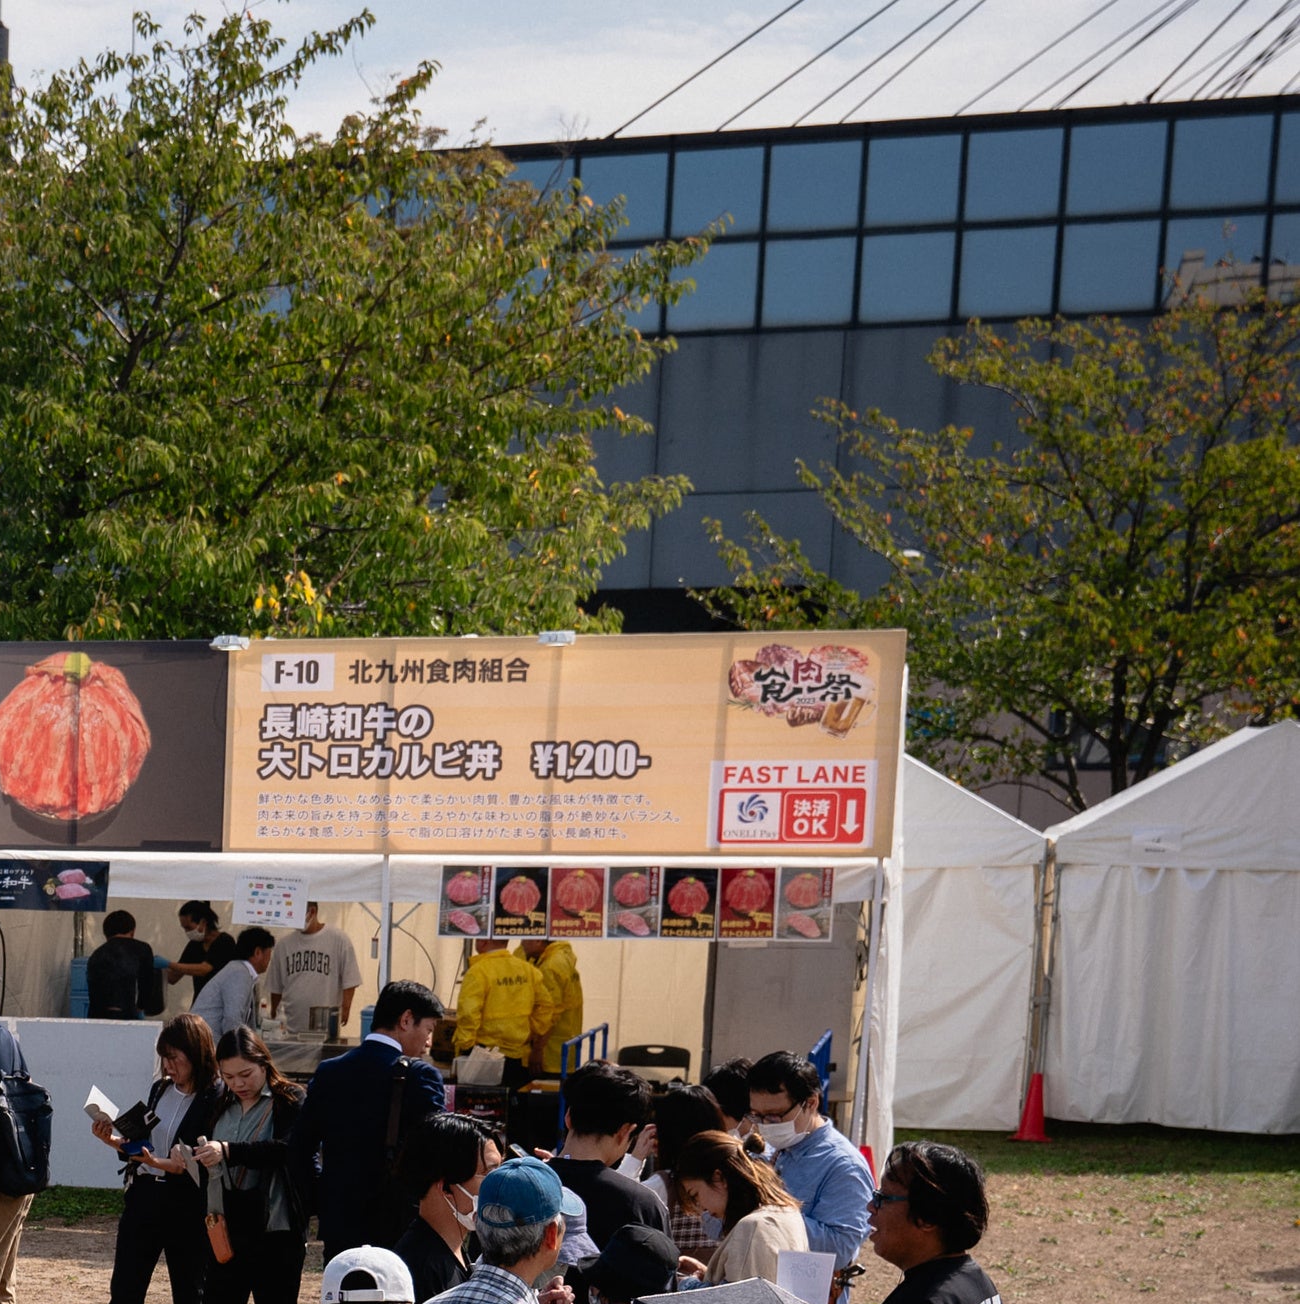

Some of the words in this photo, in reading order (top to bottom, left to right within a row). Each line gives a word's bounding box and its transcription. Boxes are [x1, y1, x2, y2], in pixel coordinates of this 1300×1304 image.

[274, 660, 319, 684] F-10
[348, 658, 530, 684] 北九州食肉組合
[259, 703, 434, 741] 長崎和牛の
[258, 742, 502, 780] 大トロカルビ丼
[723, 766, 788, 784] FAST
[797, 766, 866, 783] LANE
[793, 799, 830, 817] 決済
[759, 830, 778, 840] Pay
[793, 819, 829, 835] OK
